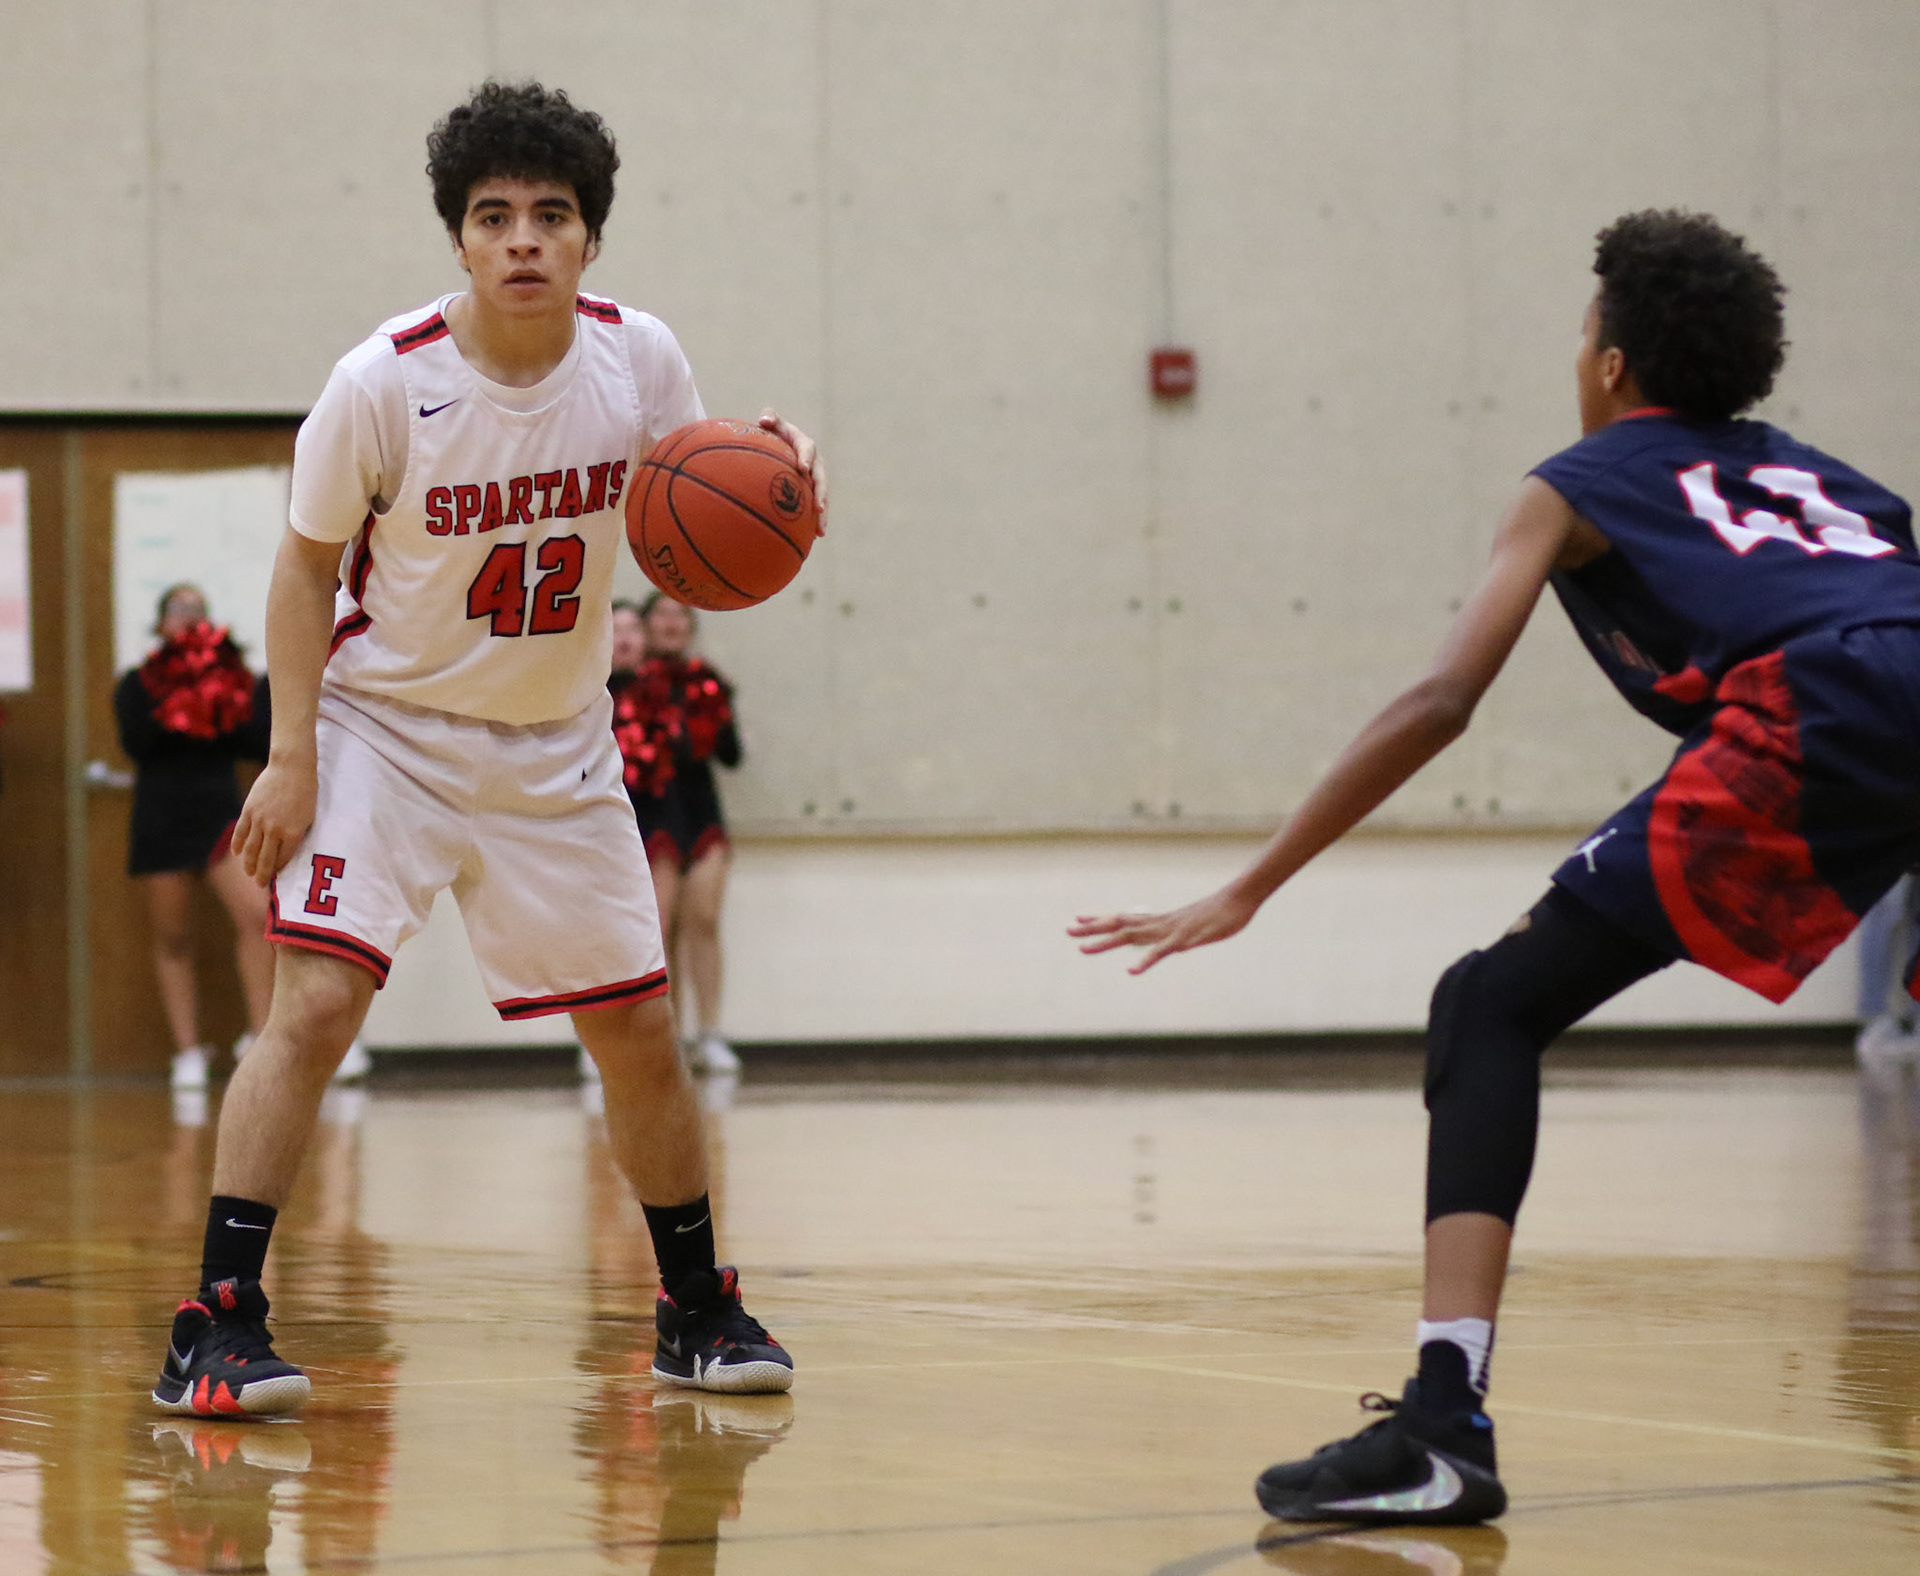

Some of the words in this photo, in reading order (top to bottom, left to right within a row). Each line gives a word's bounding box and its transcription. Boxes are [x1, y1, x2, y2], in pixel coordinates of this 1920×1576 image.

[425, 459, 628, 537] SPARTANS
[466, 533, 586, 637] 42
[303, 853, 346, 917] E
